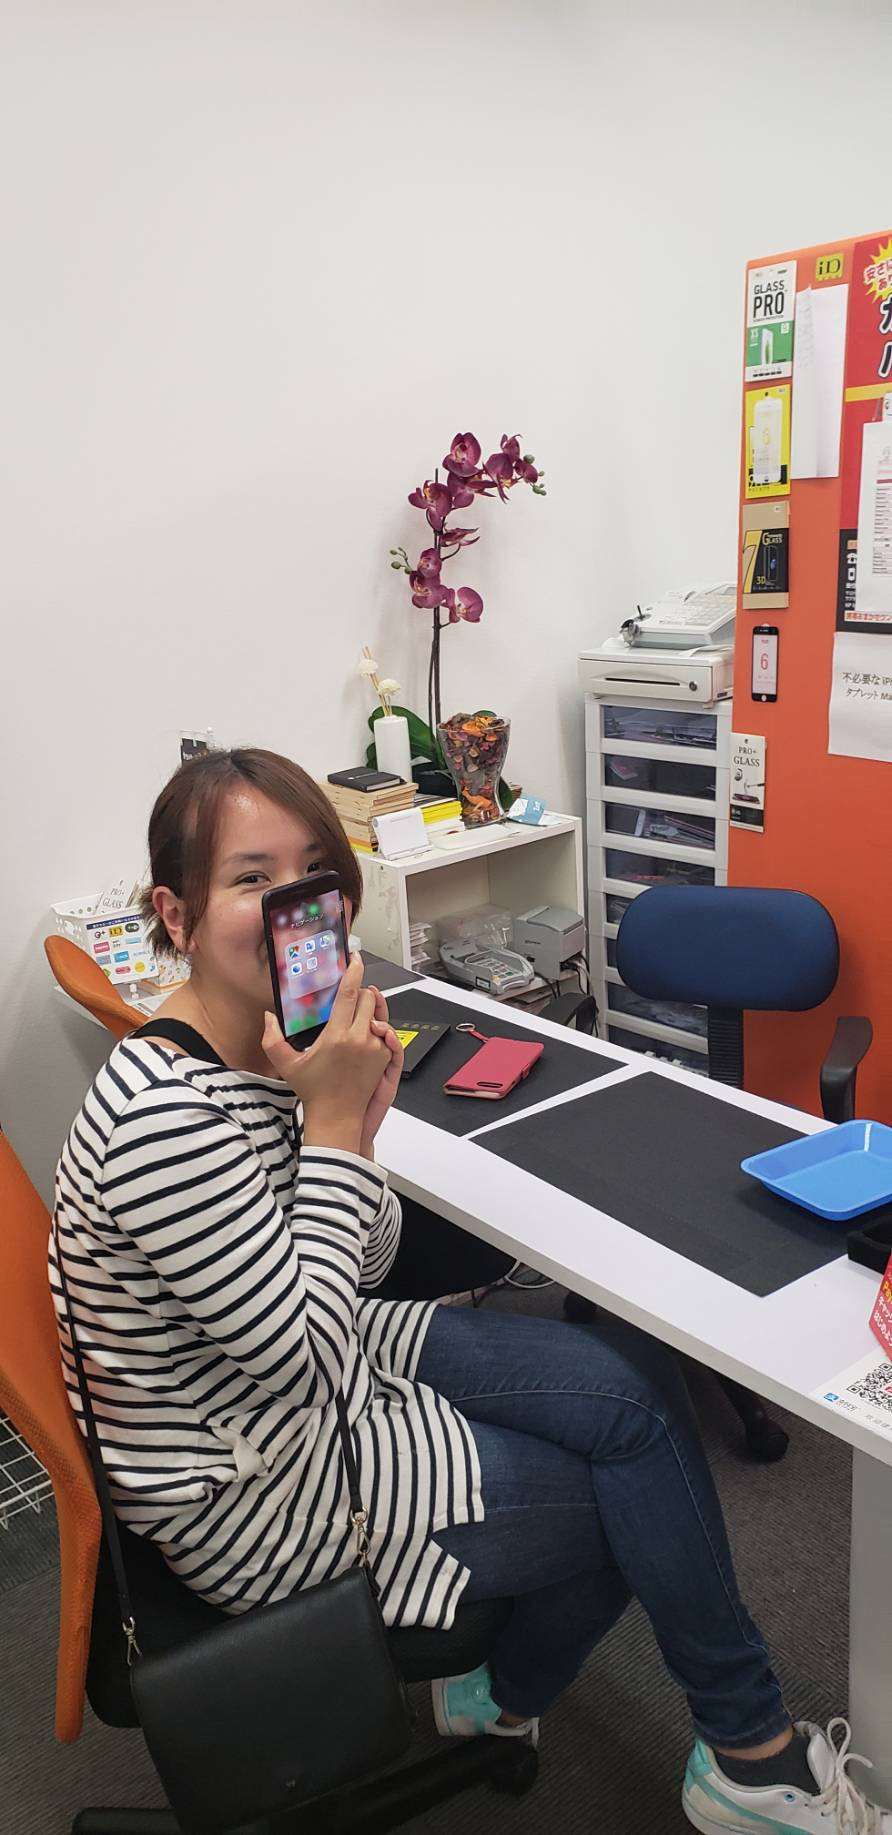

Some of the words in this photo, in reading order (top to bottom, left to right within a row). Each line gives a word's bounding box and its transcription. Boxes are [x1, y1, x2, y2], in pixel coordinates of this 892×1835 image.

[753, 279, 785, 295] GLASS
[753, 291, 785, 318] PRO
[733, 756, 760, 768] GLASS
